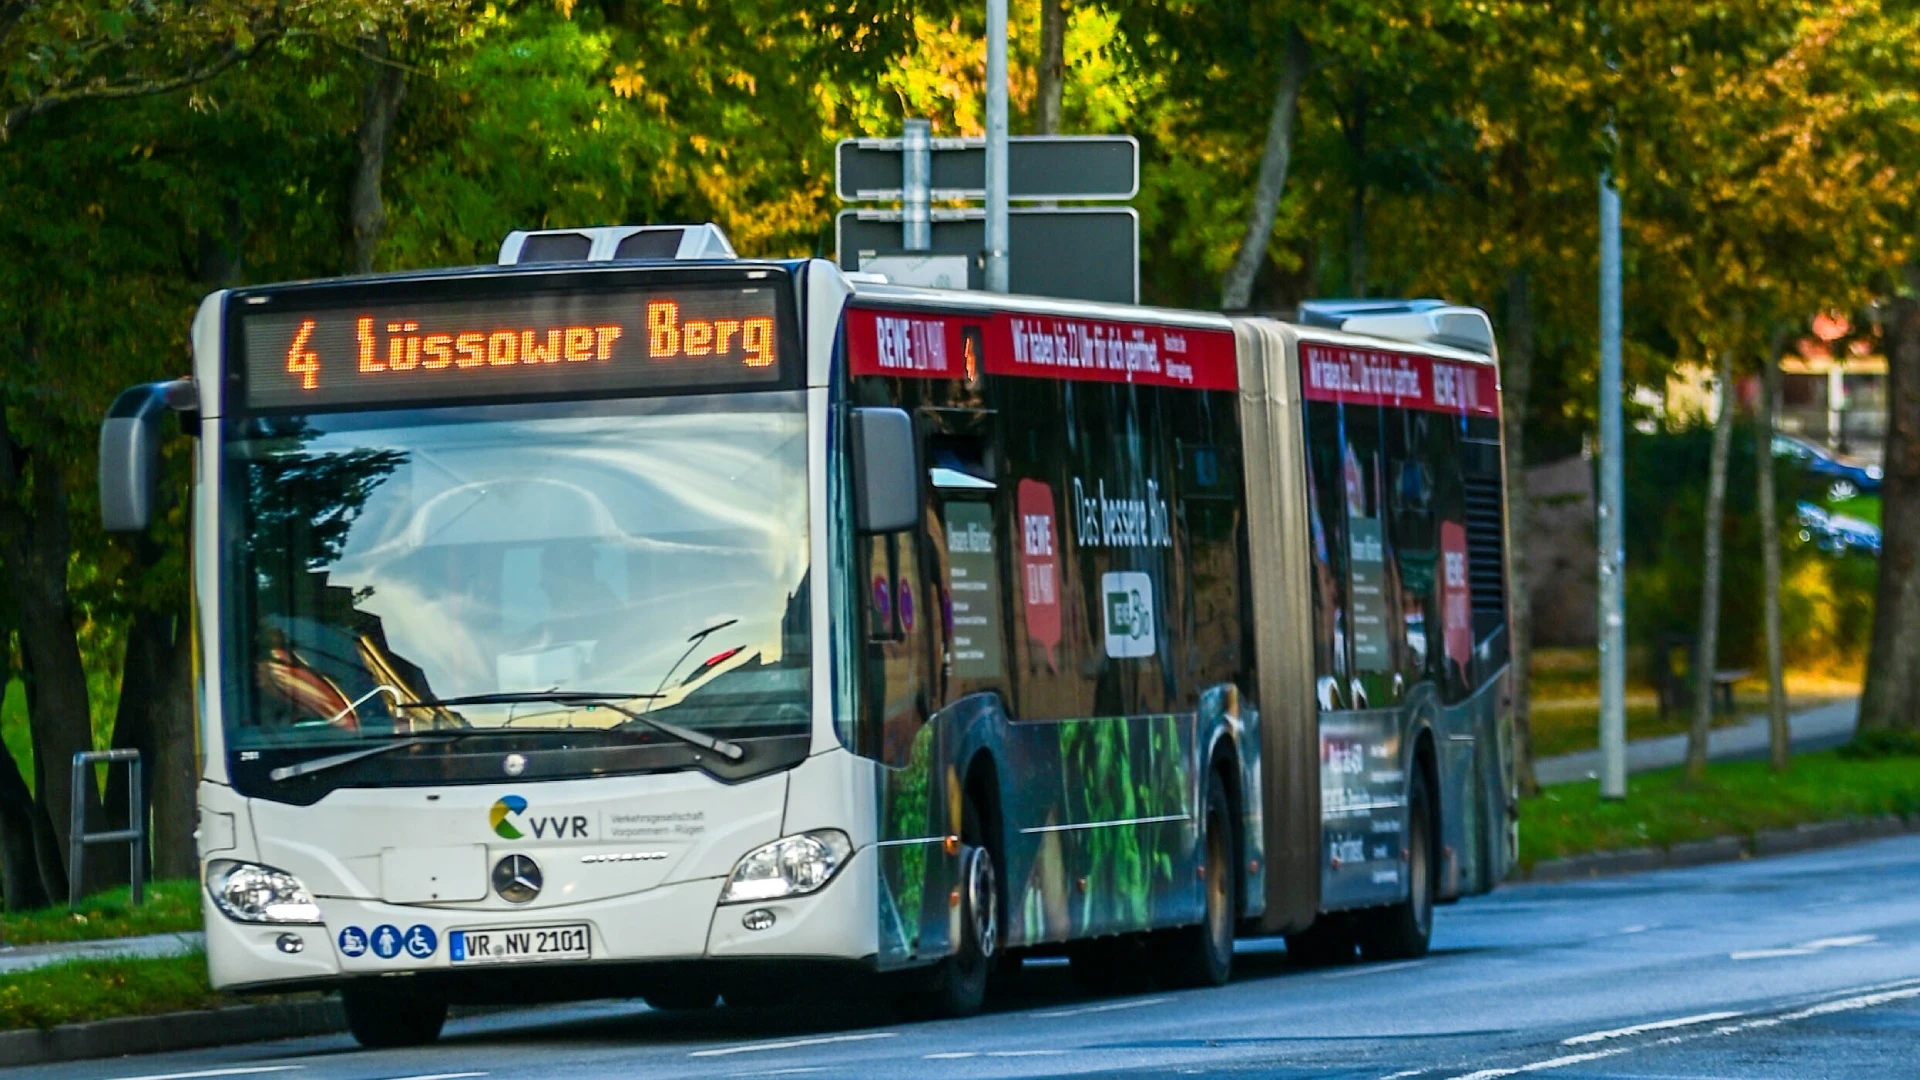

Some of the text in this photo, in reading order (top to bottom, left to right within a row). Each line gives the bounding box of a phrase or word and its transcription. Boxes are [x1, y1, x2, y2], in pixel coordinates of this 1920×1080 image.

[286, 299, 775, 390] 4 Lüssower Berg
[876, 316, 913, 370] REWE
[1074, 477, 1099, 546] Das
[1099, 478, 1148, 547] bessere
[1024, 515, 1053, 556] REWE
[529, 815, 588, 839] VVR
[611, 810, 705, 825] Verkehrsgesellschaft
[465, 929, 586, 957] VR NV 2101
